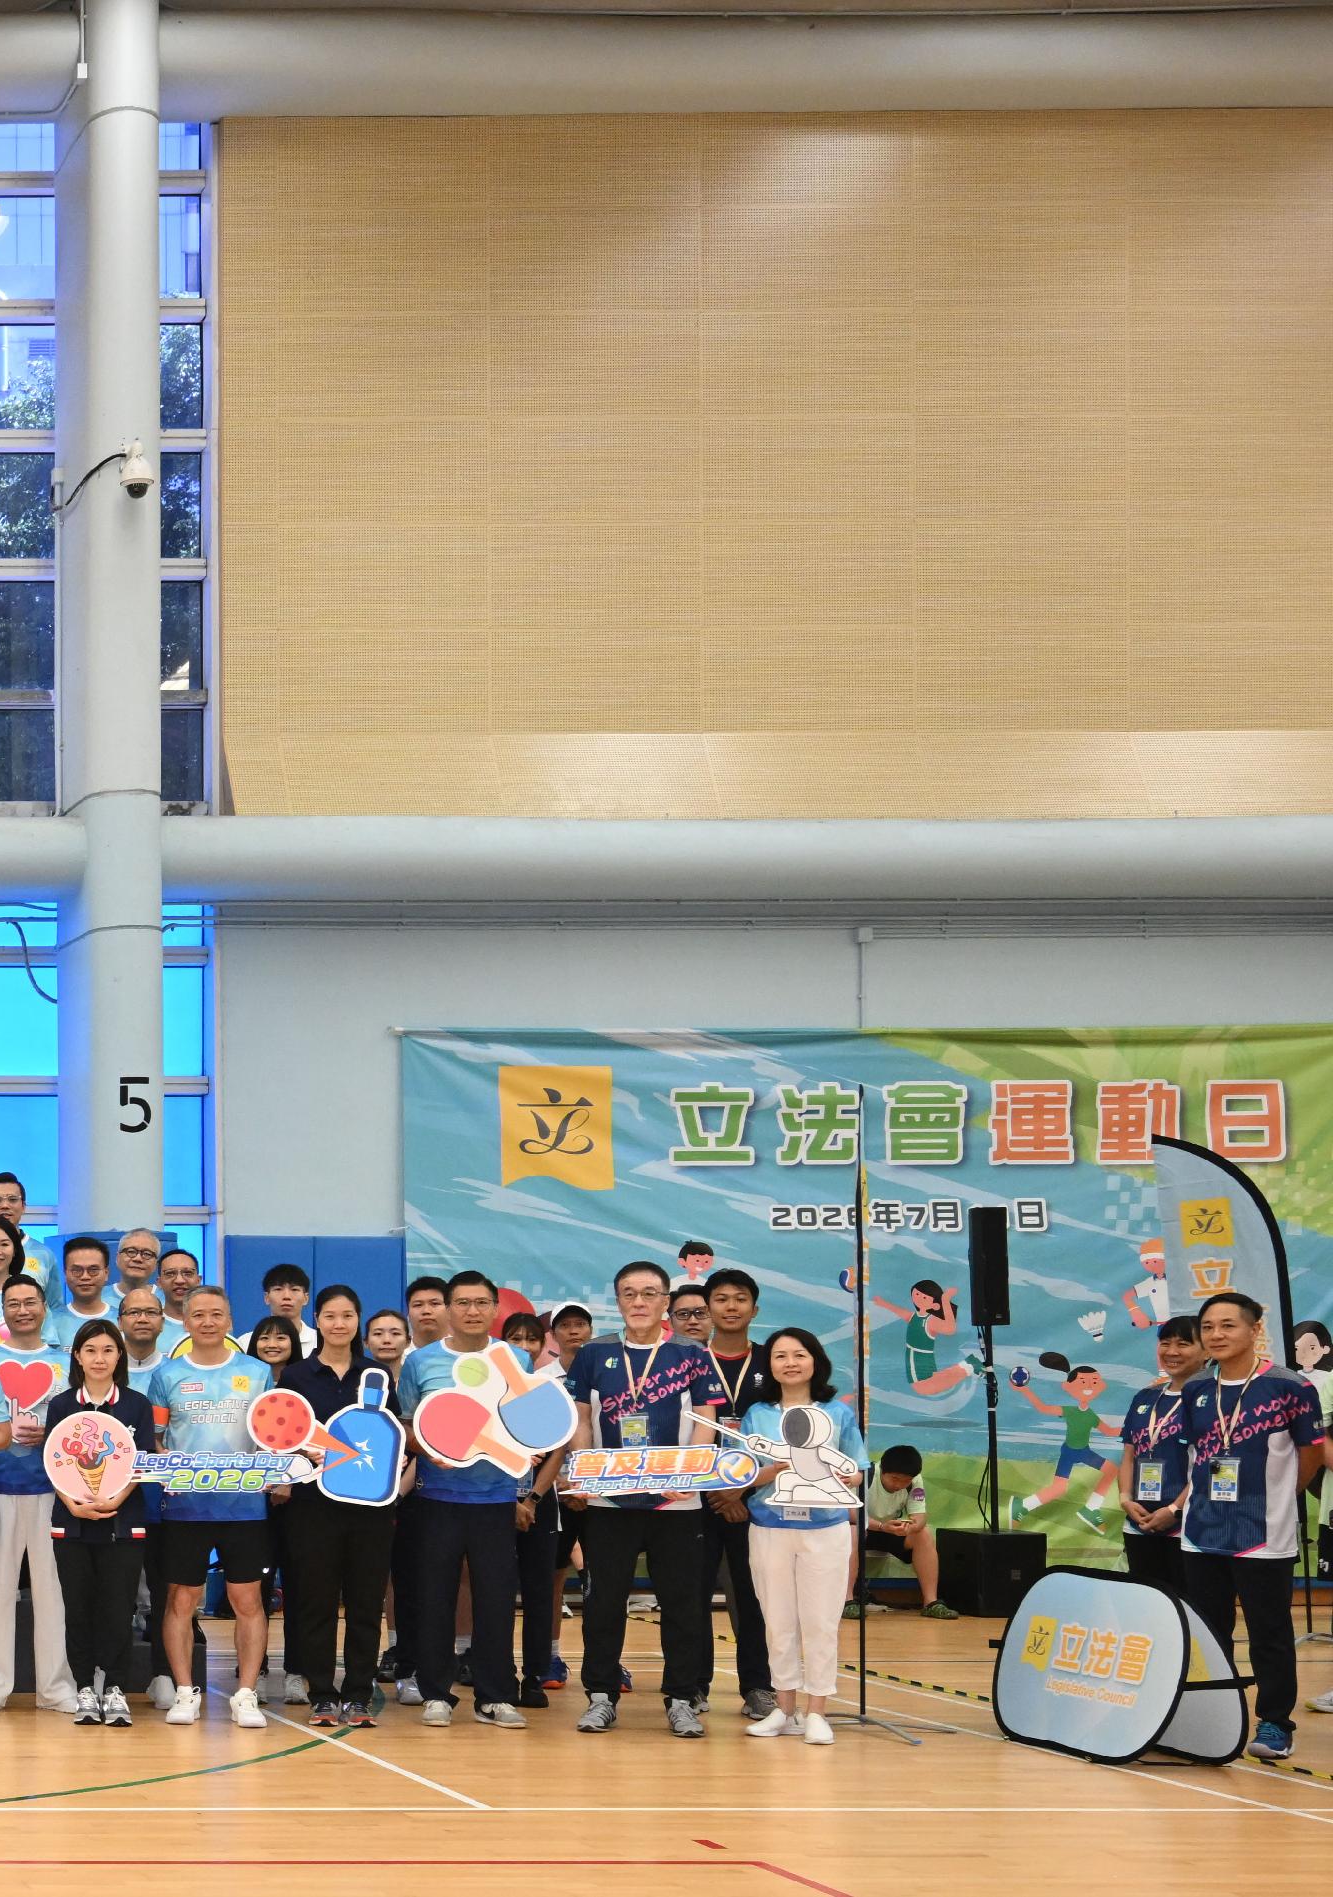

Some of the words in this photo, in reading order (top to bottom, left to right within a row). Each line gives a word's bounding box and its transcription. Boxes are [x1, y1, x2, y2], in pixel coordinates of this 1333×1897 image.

[119, 1076, 153, 1134] 5
[670, 1080, 1286, 1166] 立法會運動日
[177, 1400, 249, 1412] LEGISLATIVE
[190, 1413, 237, 1424] COUNCIL
[135, 1452, 191, 1470] LegCo
[194, 1452, 253, 1469] Sports
[254, 1454, 294, 1470] Day
[574, 1448, 717, 1477] 普及運動
[168, 1469, 266, 1491] 2026
[583, 1477, 637, 1491] Sports
[639, 1476, 665, 1489] For
[665, 1475, 690, 1488] All
[1050, 1622, 1154, 1686] 立法會
[1045, 1675, 1096, 1701] Legislative
[1097, 1686, 1138, 1709] Council
